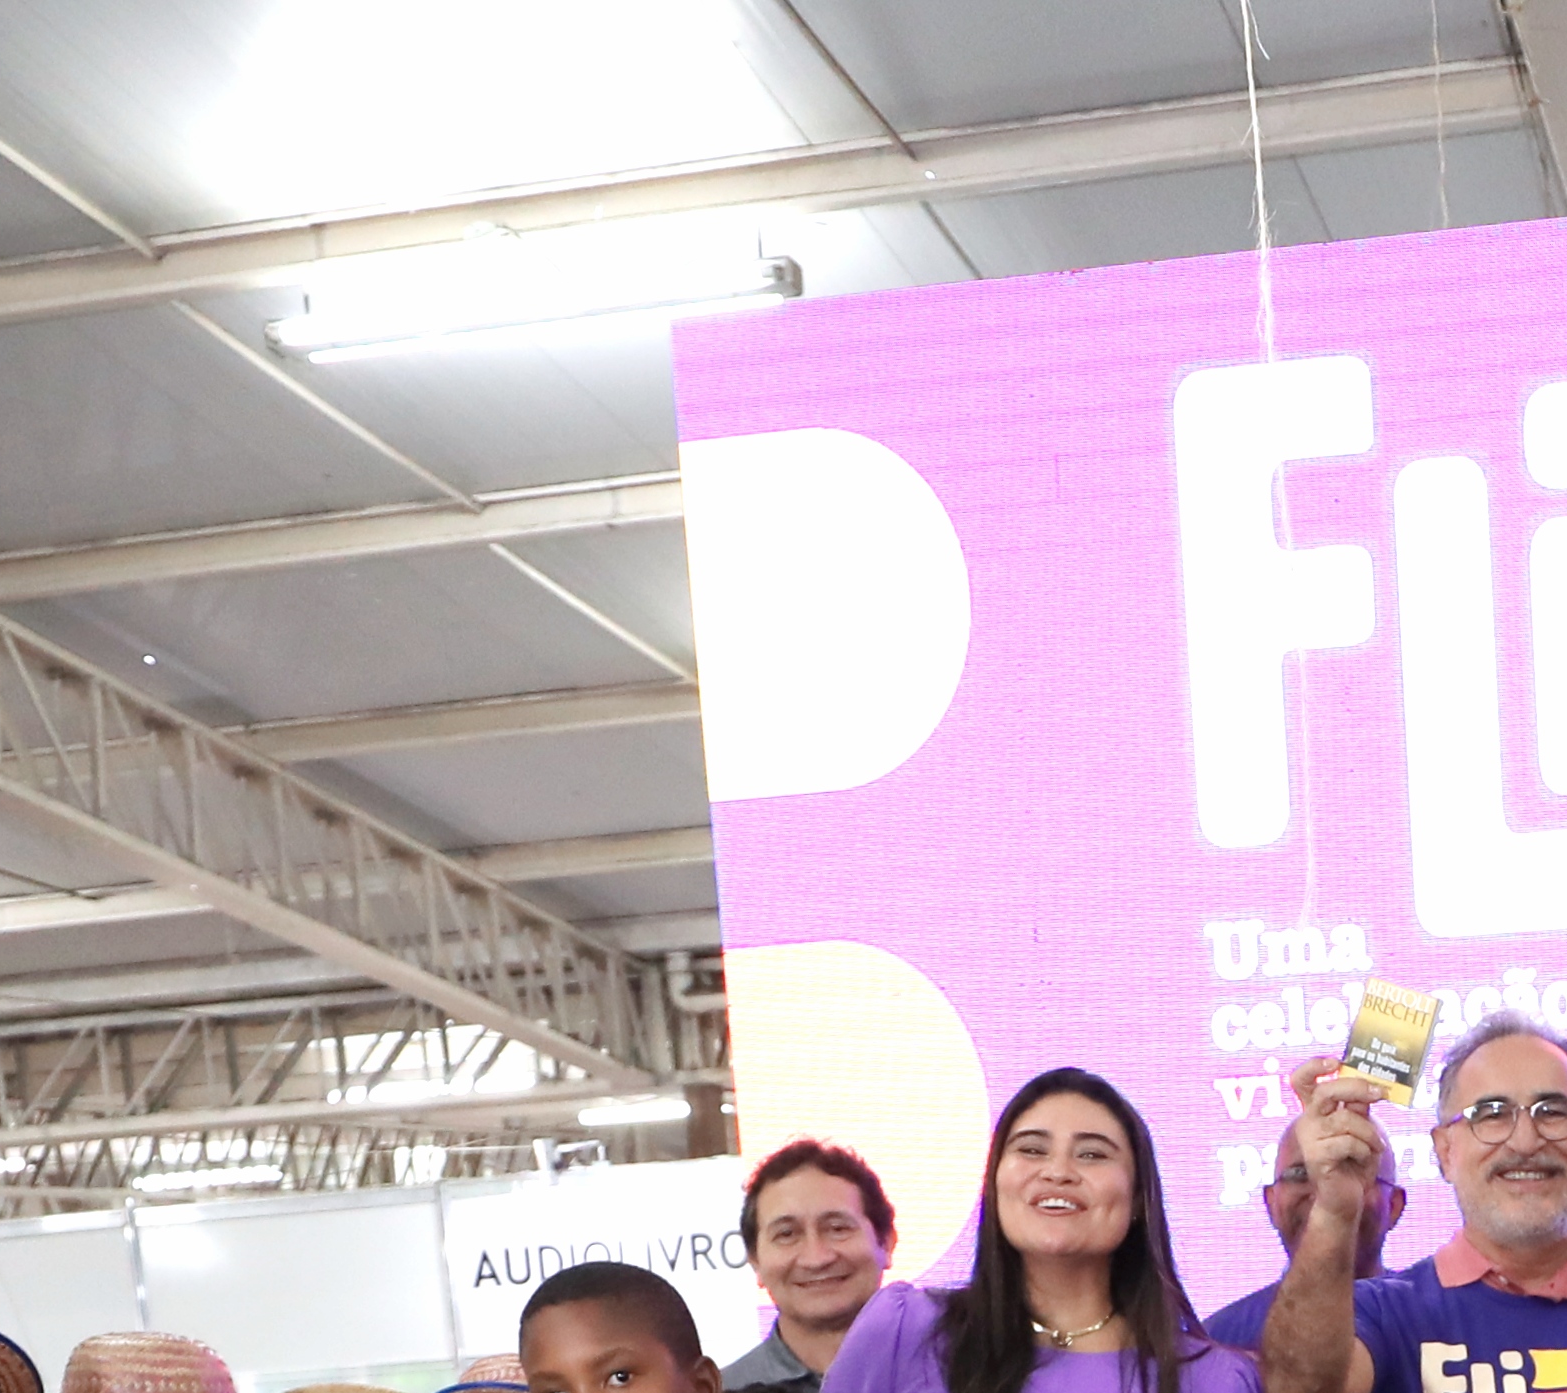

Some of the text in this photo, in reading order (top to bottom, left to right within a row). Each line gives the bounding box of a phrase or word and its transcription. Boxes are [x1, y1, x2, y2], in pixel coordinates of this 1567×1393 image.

[1203, 919, 1373, 981] Uma
[1363, 993, 1430, 1027] BRECHT
[1365, 977, 1435, 1013] BERTOLT
